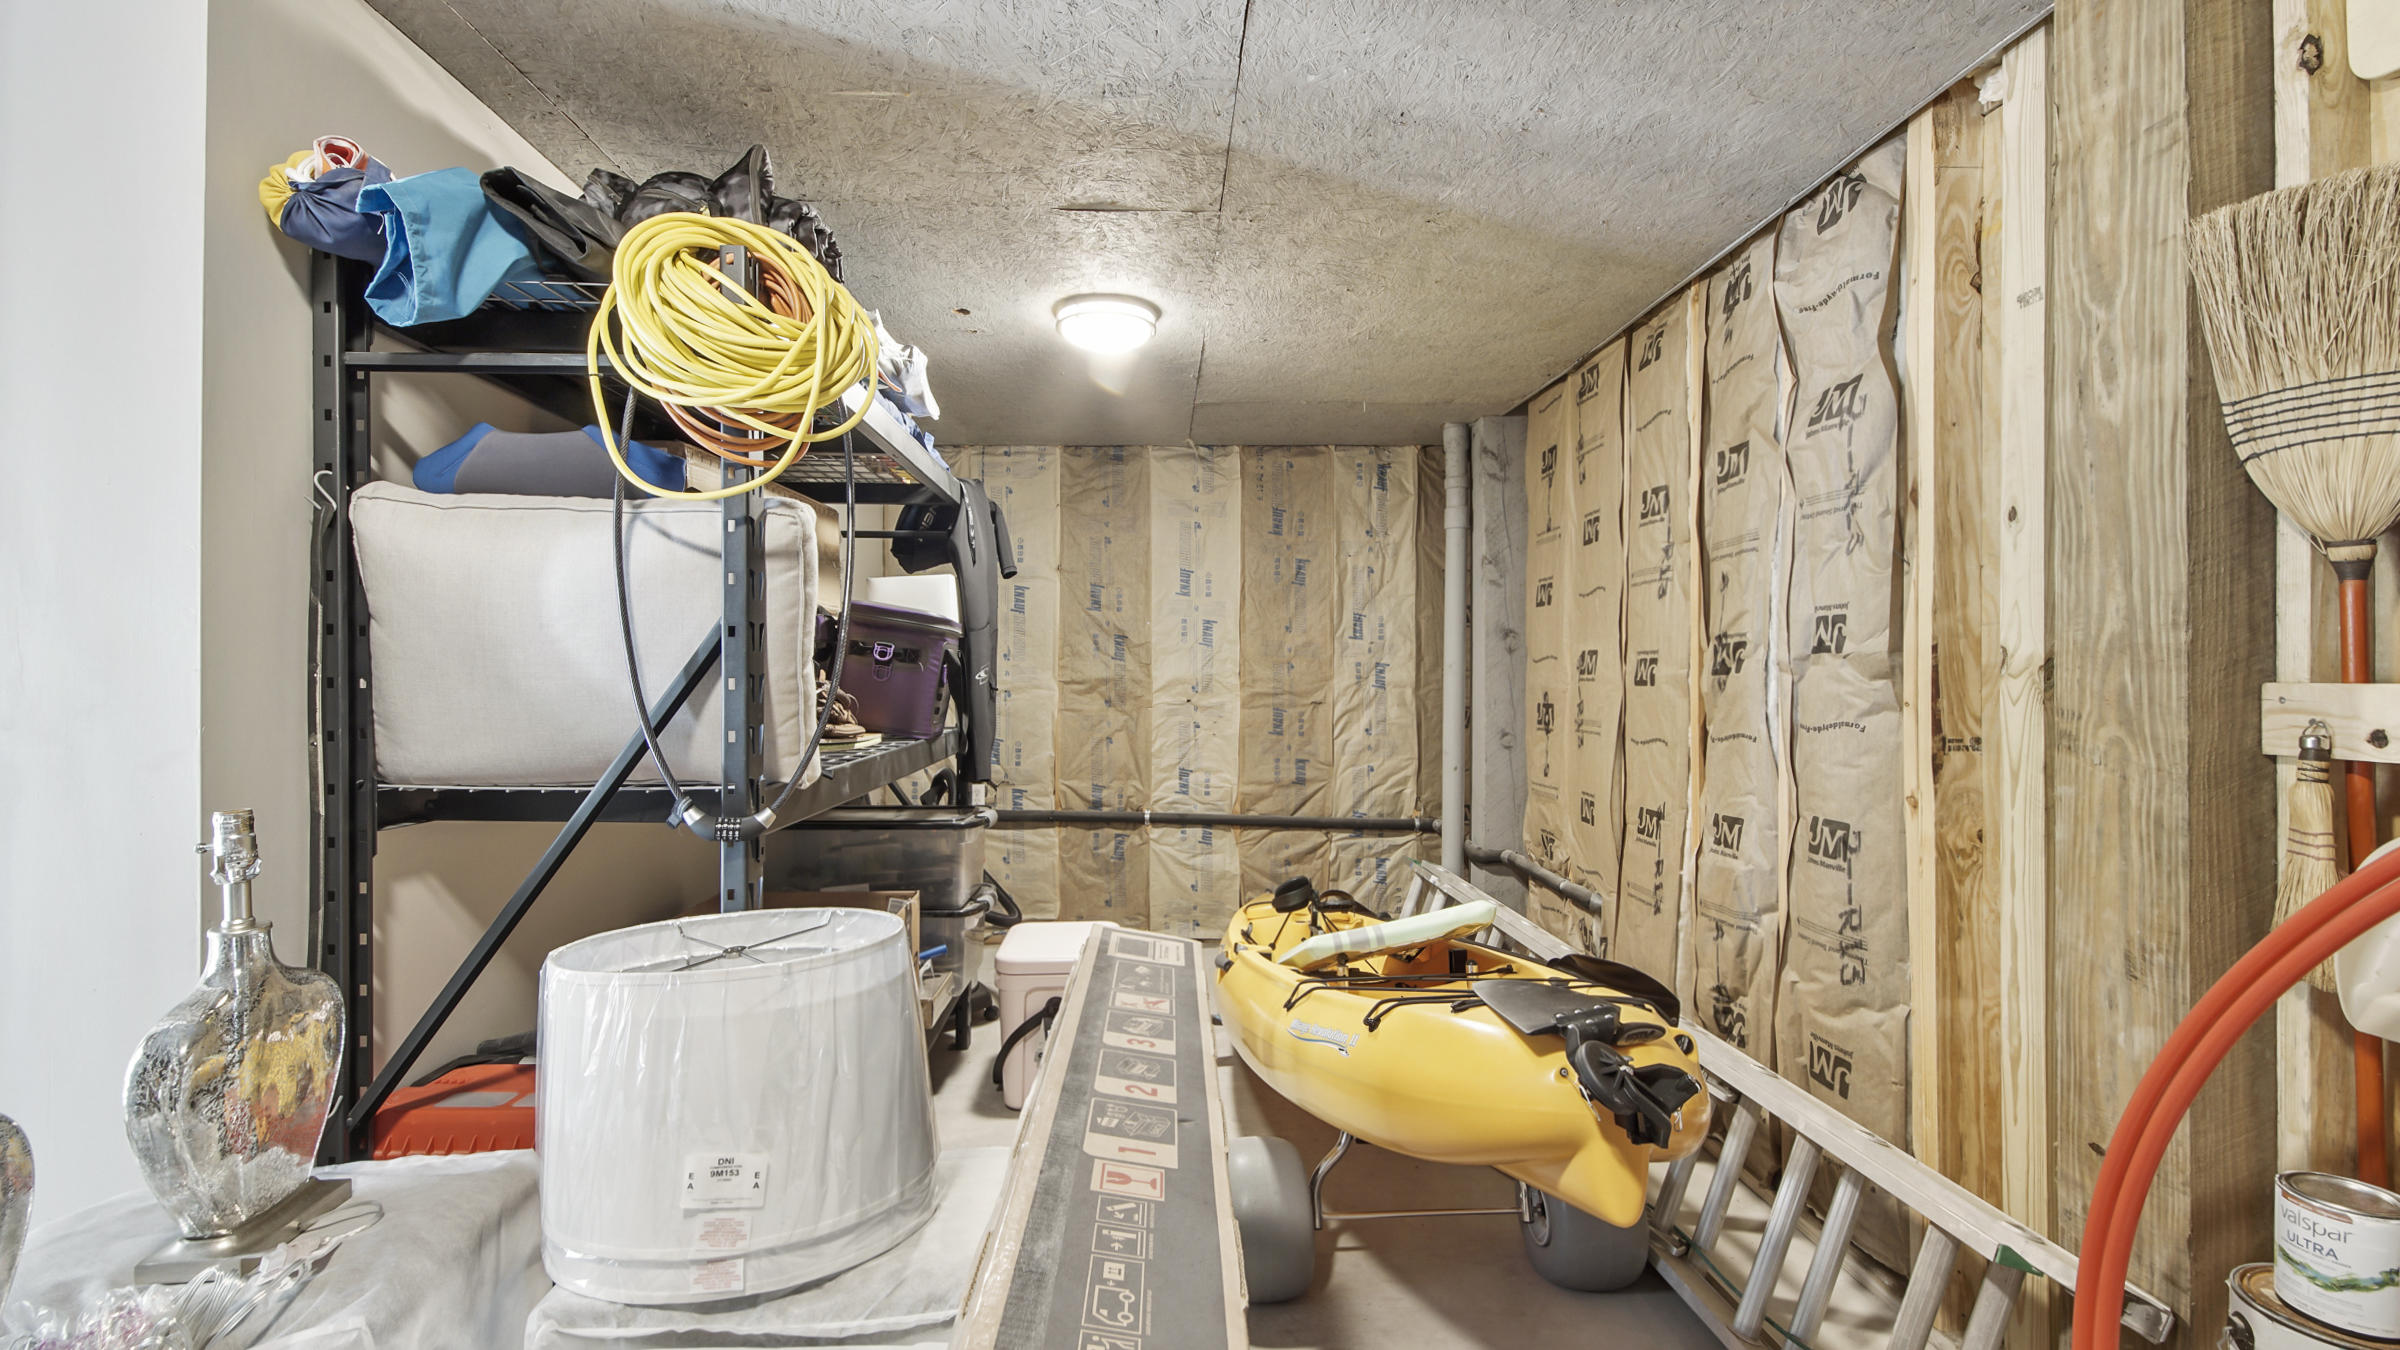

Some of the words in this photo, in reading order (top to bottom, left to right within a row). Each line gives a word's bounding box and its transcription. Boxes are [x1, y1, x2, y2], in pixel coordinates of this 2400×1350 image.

[1808, 373, 1864, 428] JM
[1717, 440, 1749, 485] JM
[1641, 485, 1669, 520] JM
[1268, 506, 1286, 536] KNAUF
[1176, 568, 1194, 597] KNAUF
[1292, 558, 1311, 586] KNAUF
[1010, 584, 1030, 614] KNAUF
[1086, 582, 1105, 612] KNAUF
[1111, 633, 1128, 662] KNAUF
[1199, 619, 1217, 648] KNAUF
[1811, 614, 1847, 654] JM
[1372, 662, 1390, 690] KNAUF
[1268, 707, 1287, 736] KNAUF
[1175, 766, 1193, 795] KNAUF
[1292, 758, 1310, 786] KNAUF
[1713, 813, 1744, 851] JM
[1808, 816, 1850, 862] JM
[1127, 1038, 1156, 1048] 3
[1809, 1040, 1851, 1100] JM
[1124, 1085, 1158, 1097] 2
[717, 1157, 735, 1166] DNI
[1118, 1146, 1157, 1156] 1
[687, 1182, 694, 1190] A
[688, 1172, 694, 1180] E
[710, 1169, 740, 1178] 9M153
[753, 1181, 760, 1189] A
[754, 1172, 760, 1180] E
[2281, 1203, 2353, 1244] valspar
[2287, 1229, 2339, 1260] ULTRA
